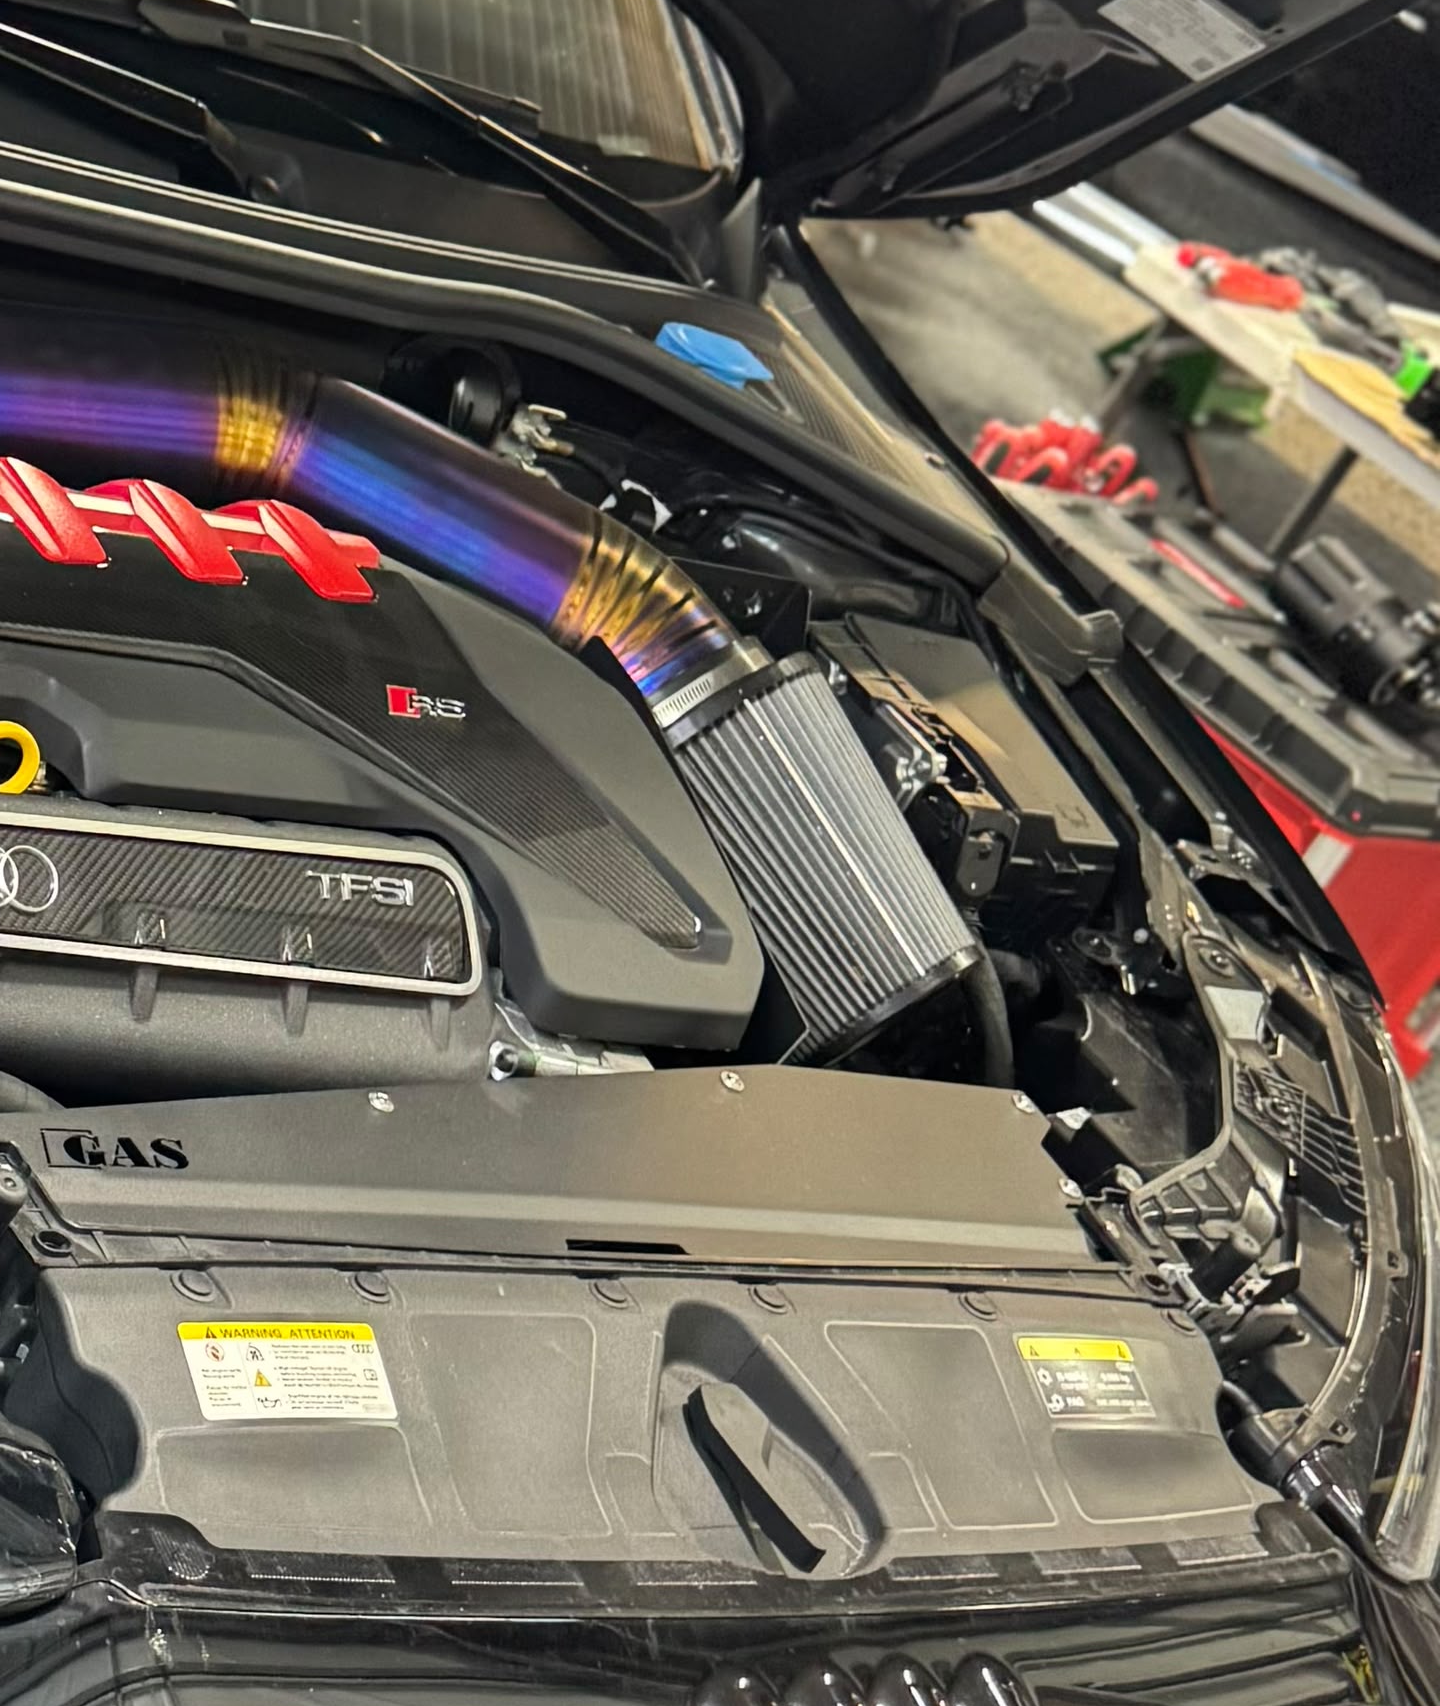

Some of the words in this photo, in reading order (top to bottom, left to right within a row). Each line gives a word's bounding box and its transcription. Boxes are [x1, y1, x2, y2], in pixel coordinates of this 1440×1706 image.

[404, 691, 466, 719] RS
[305, 870, 414, 907] TFSI
[62, 1134, 190, 1170] GAS
[218, 1327, 283, 1340] WARNING
[289, 1328, 356, 1341] ATTENTION
